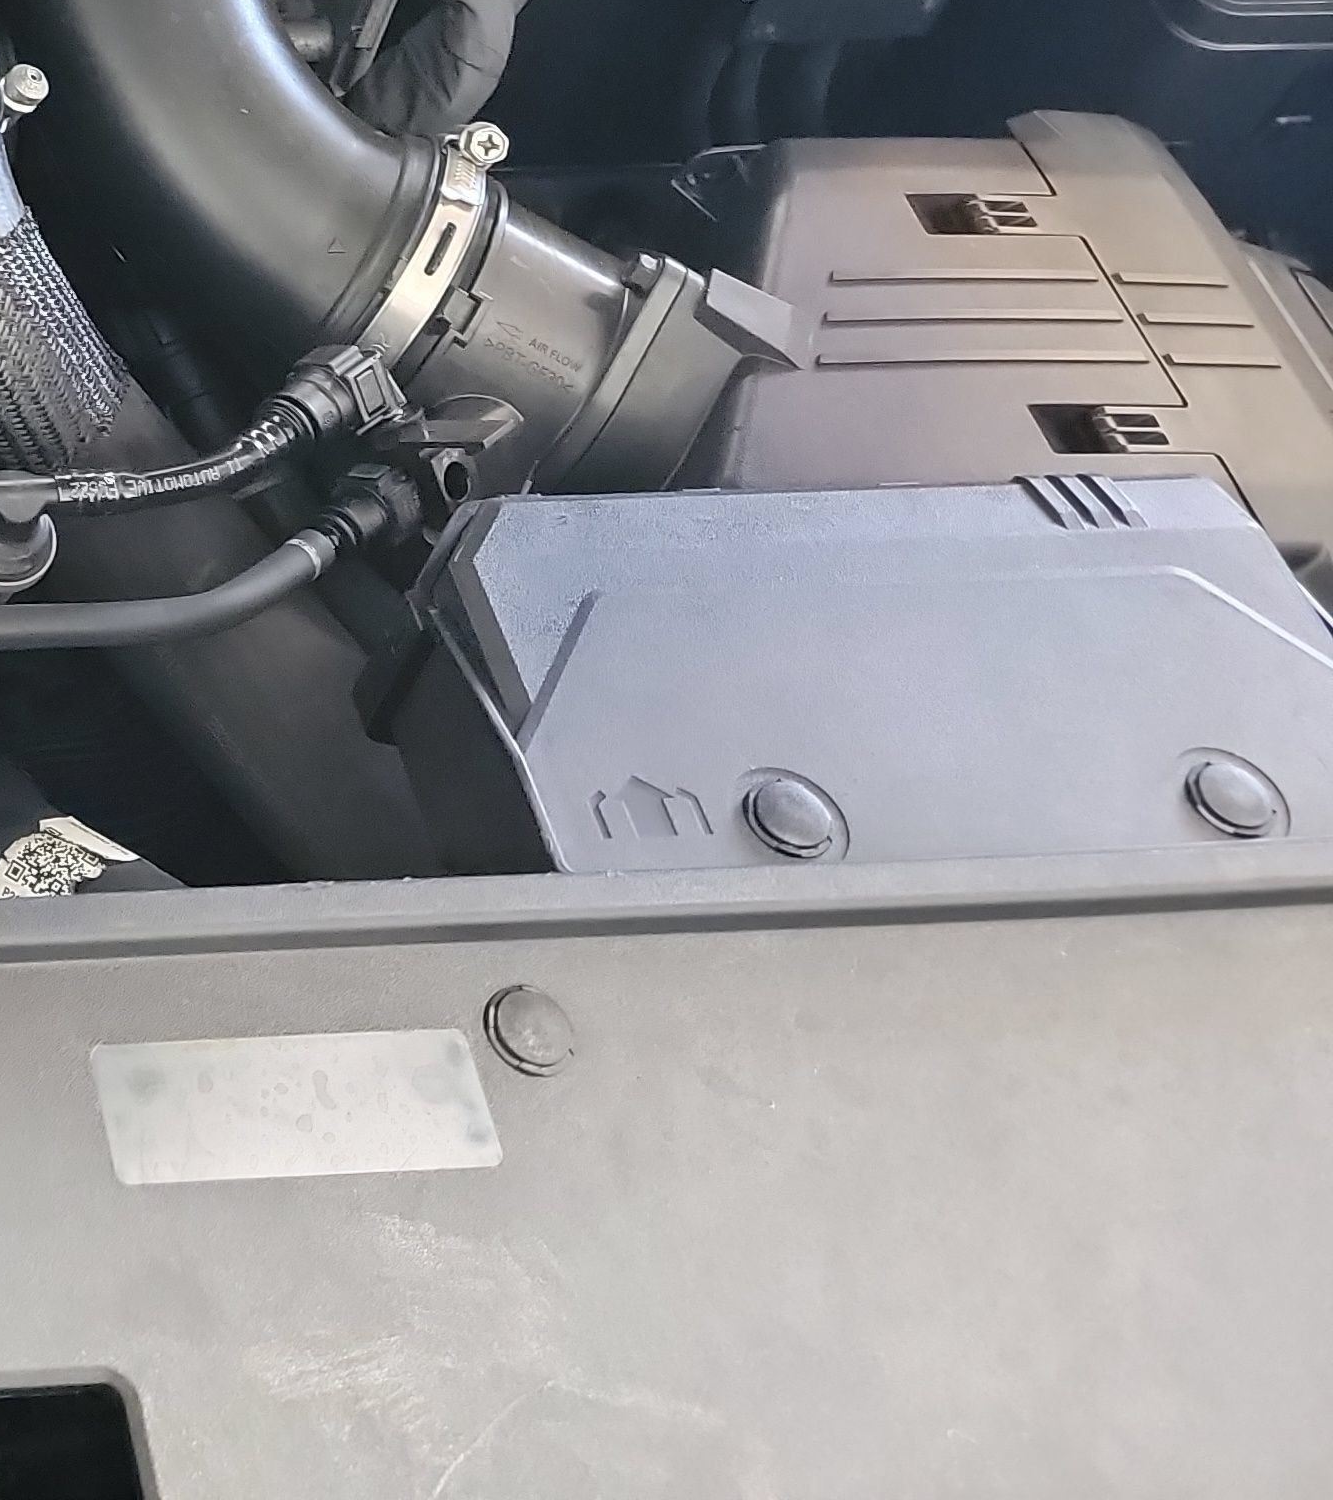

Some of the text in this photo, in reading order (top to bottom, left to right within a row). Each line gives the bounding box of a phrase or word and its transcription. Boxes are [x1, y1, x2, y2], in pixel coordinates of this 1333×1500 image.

[527, 337, 584, 372] AIR FLOW
[123, 466, 221, 497] AUTOMOTIVE
